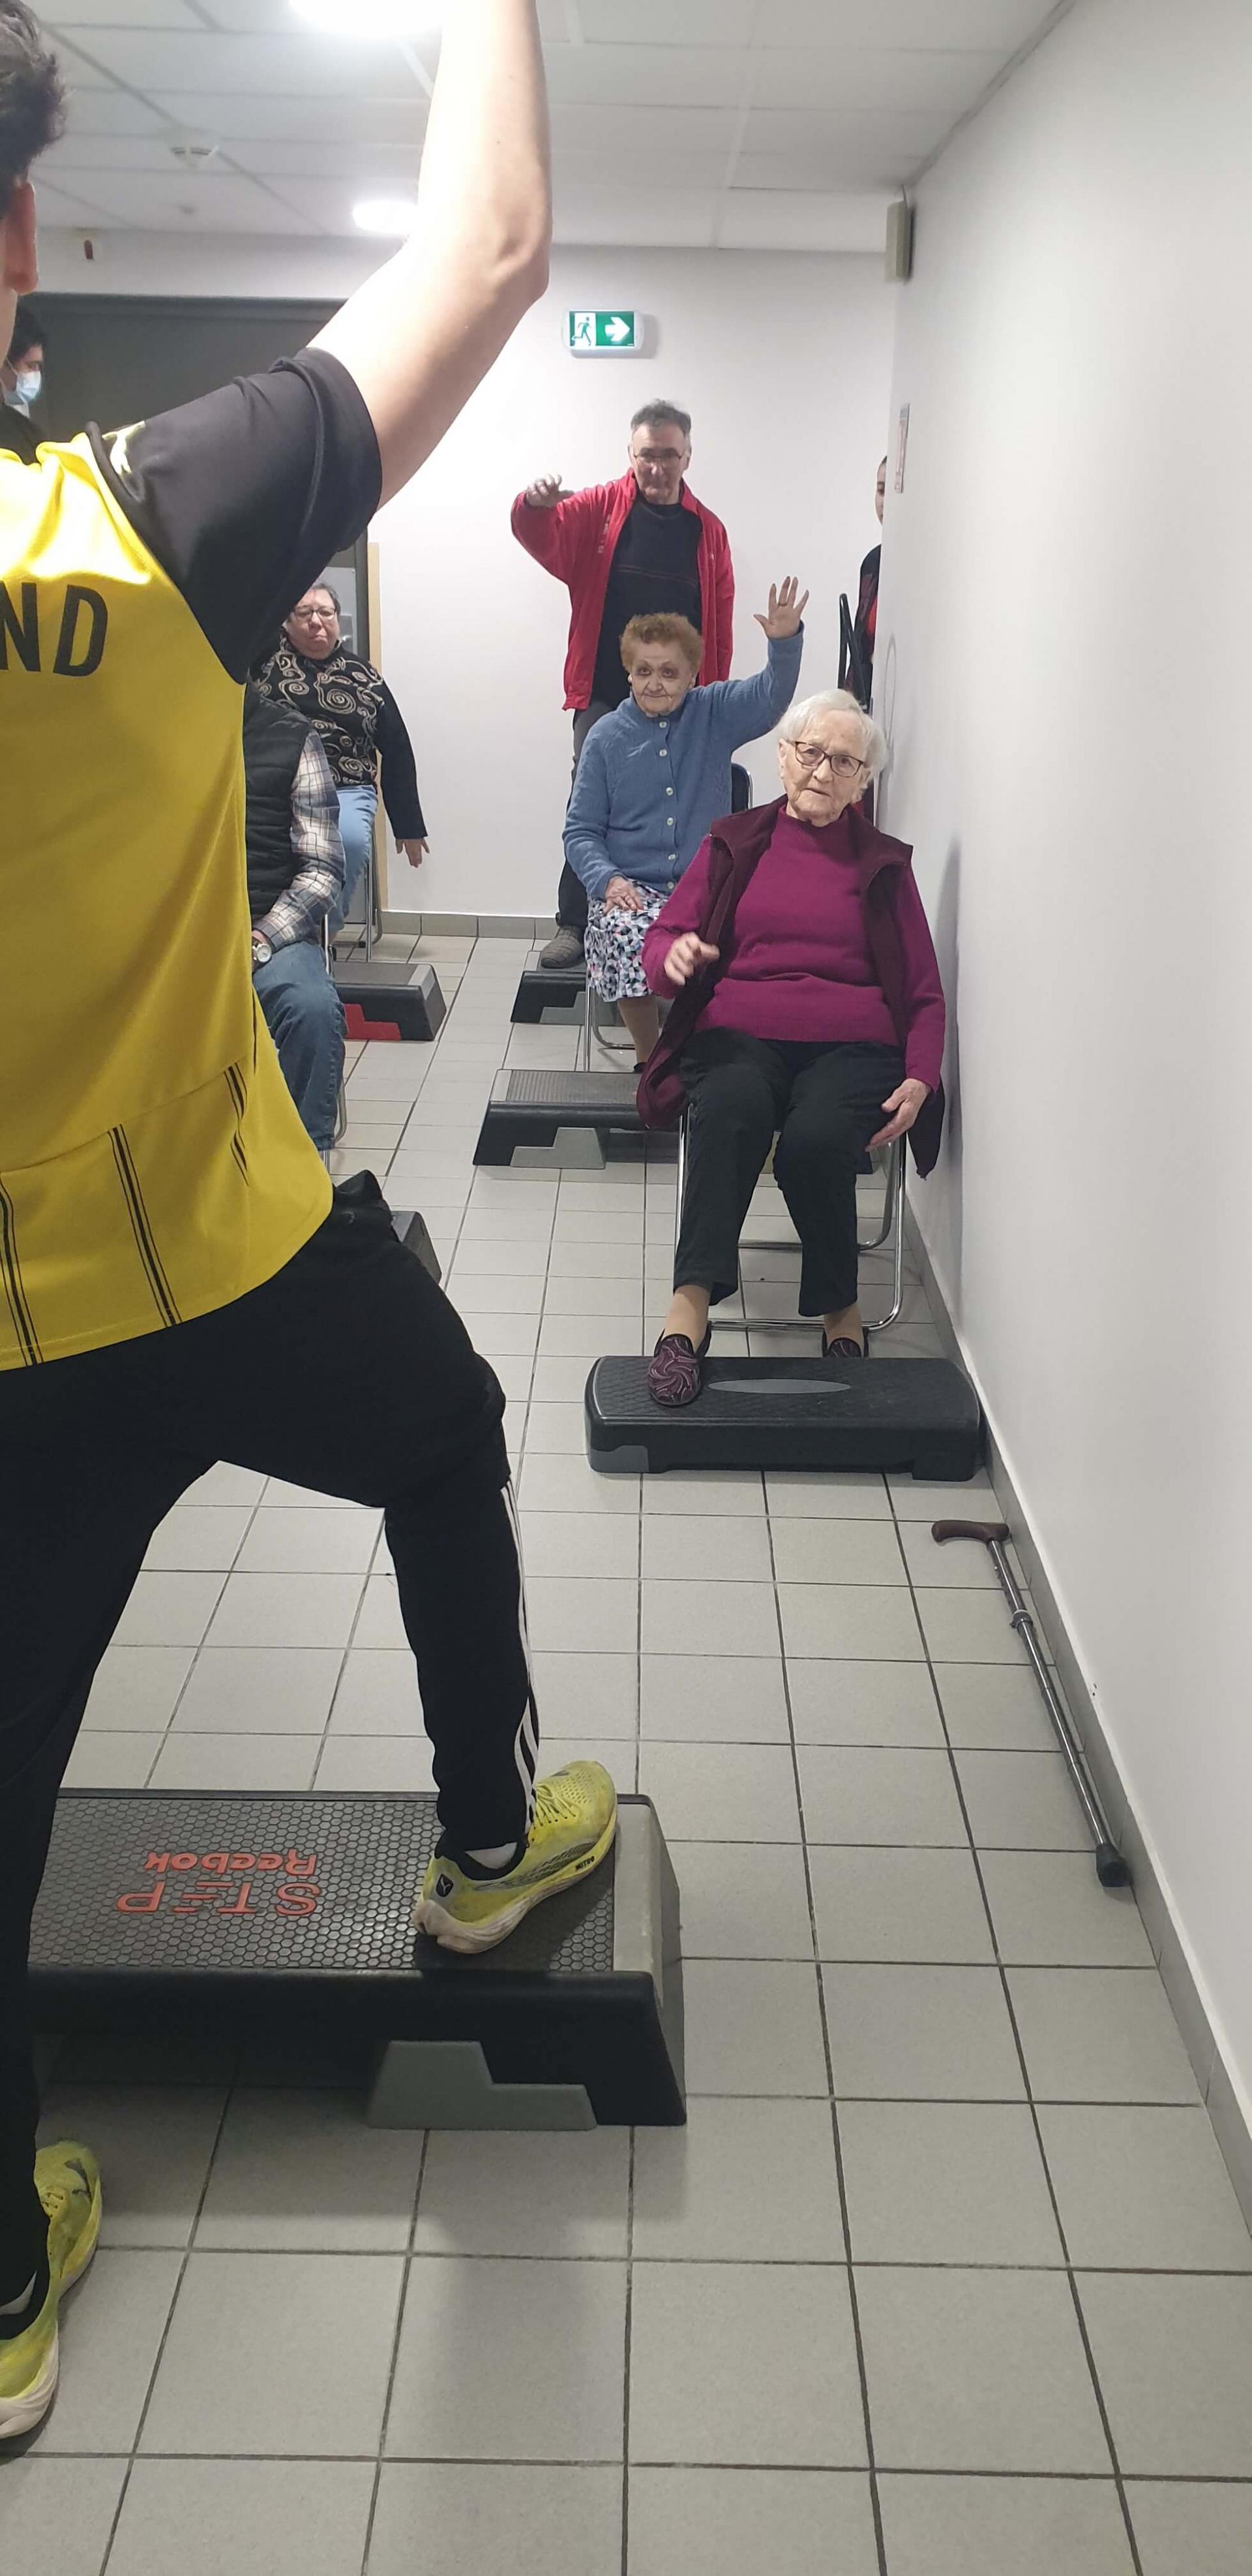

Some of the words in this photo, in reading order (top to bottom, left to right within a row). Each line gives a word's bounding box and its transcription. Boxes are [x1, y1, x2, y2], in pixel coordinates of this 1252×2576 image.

[0, 580, 108, 676] ND
[143, 1849, 318, 1876] Reebok
[116, 1881, 321, 1916] STEP
